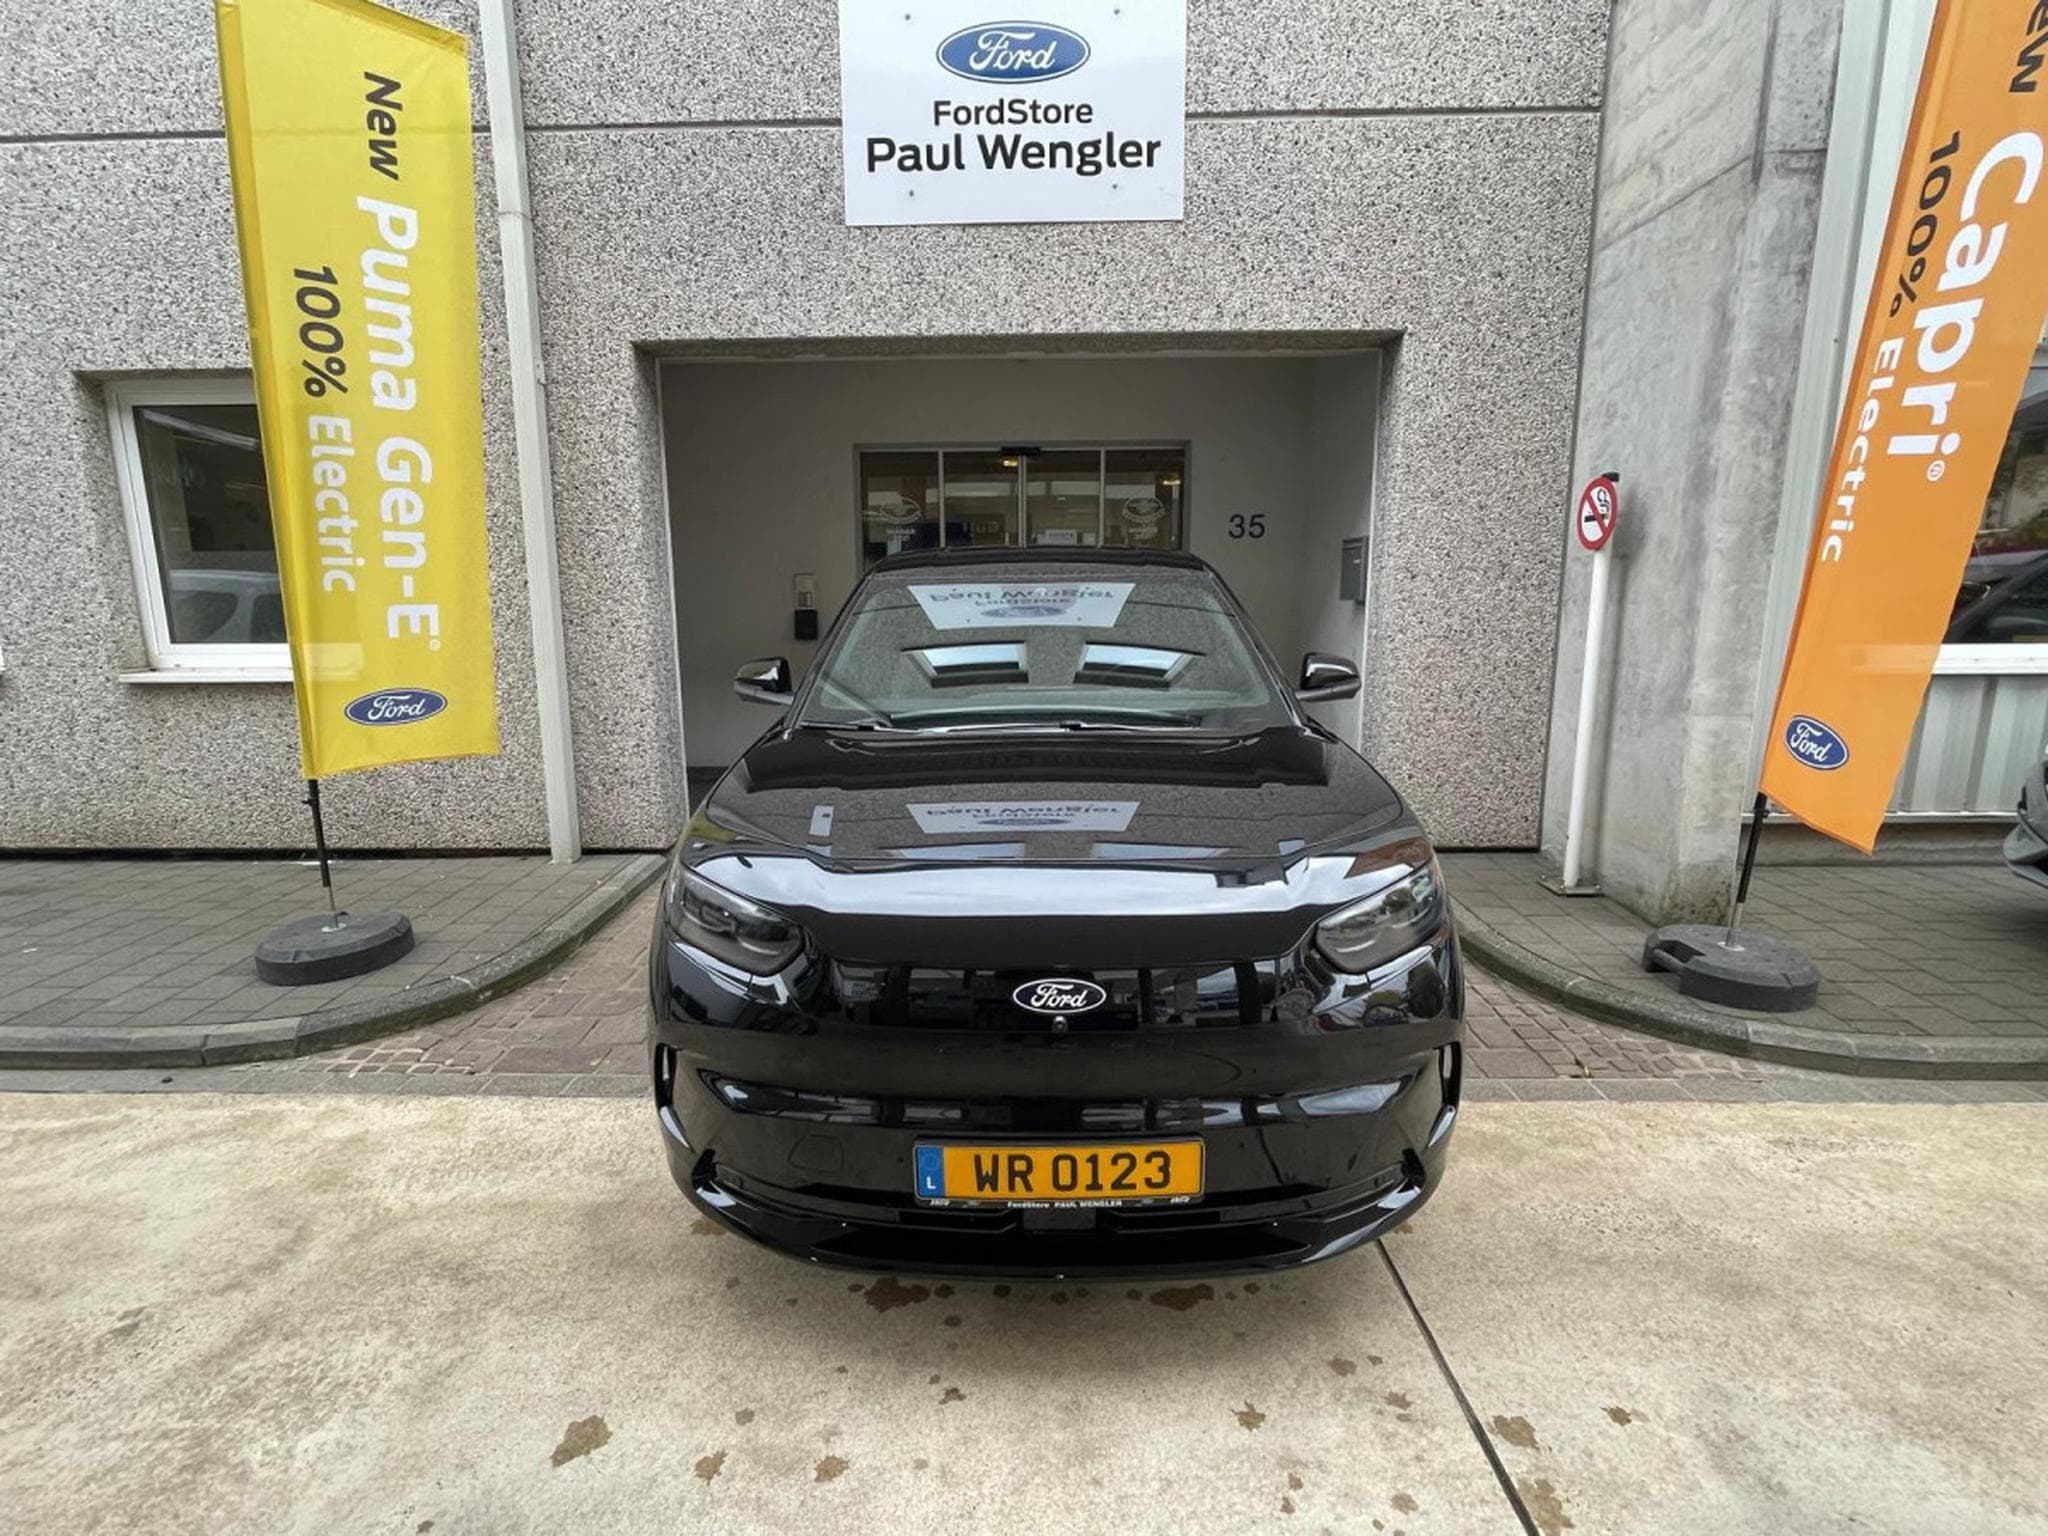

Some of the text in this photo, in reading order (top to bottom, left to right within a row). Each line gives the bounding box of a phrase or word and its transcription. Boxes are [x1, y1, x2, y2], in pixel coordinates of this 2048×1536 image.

[968, 30, 1057, 71] Ford
[364, 71, 403, 181] New
[933, 99, 1093, 126] FordStore
[866, 131, 1161, 176] Paul Wengler
[356, 195, 419, 411] Puma
[1821, 130, 1960, 563] 100% Electric
[293, 265, 365, 592] 100% Electric
[1228, 514, 1266, 539] 35
[367, 694, 426, 721] Ford
[1789, 722, 1832, 763] Ford
[1030, 982, 1089, 1008] Ford
[926, 1150, 1171, 1193] L WR 0123
